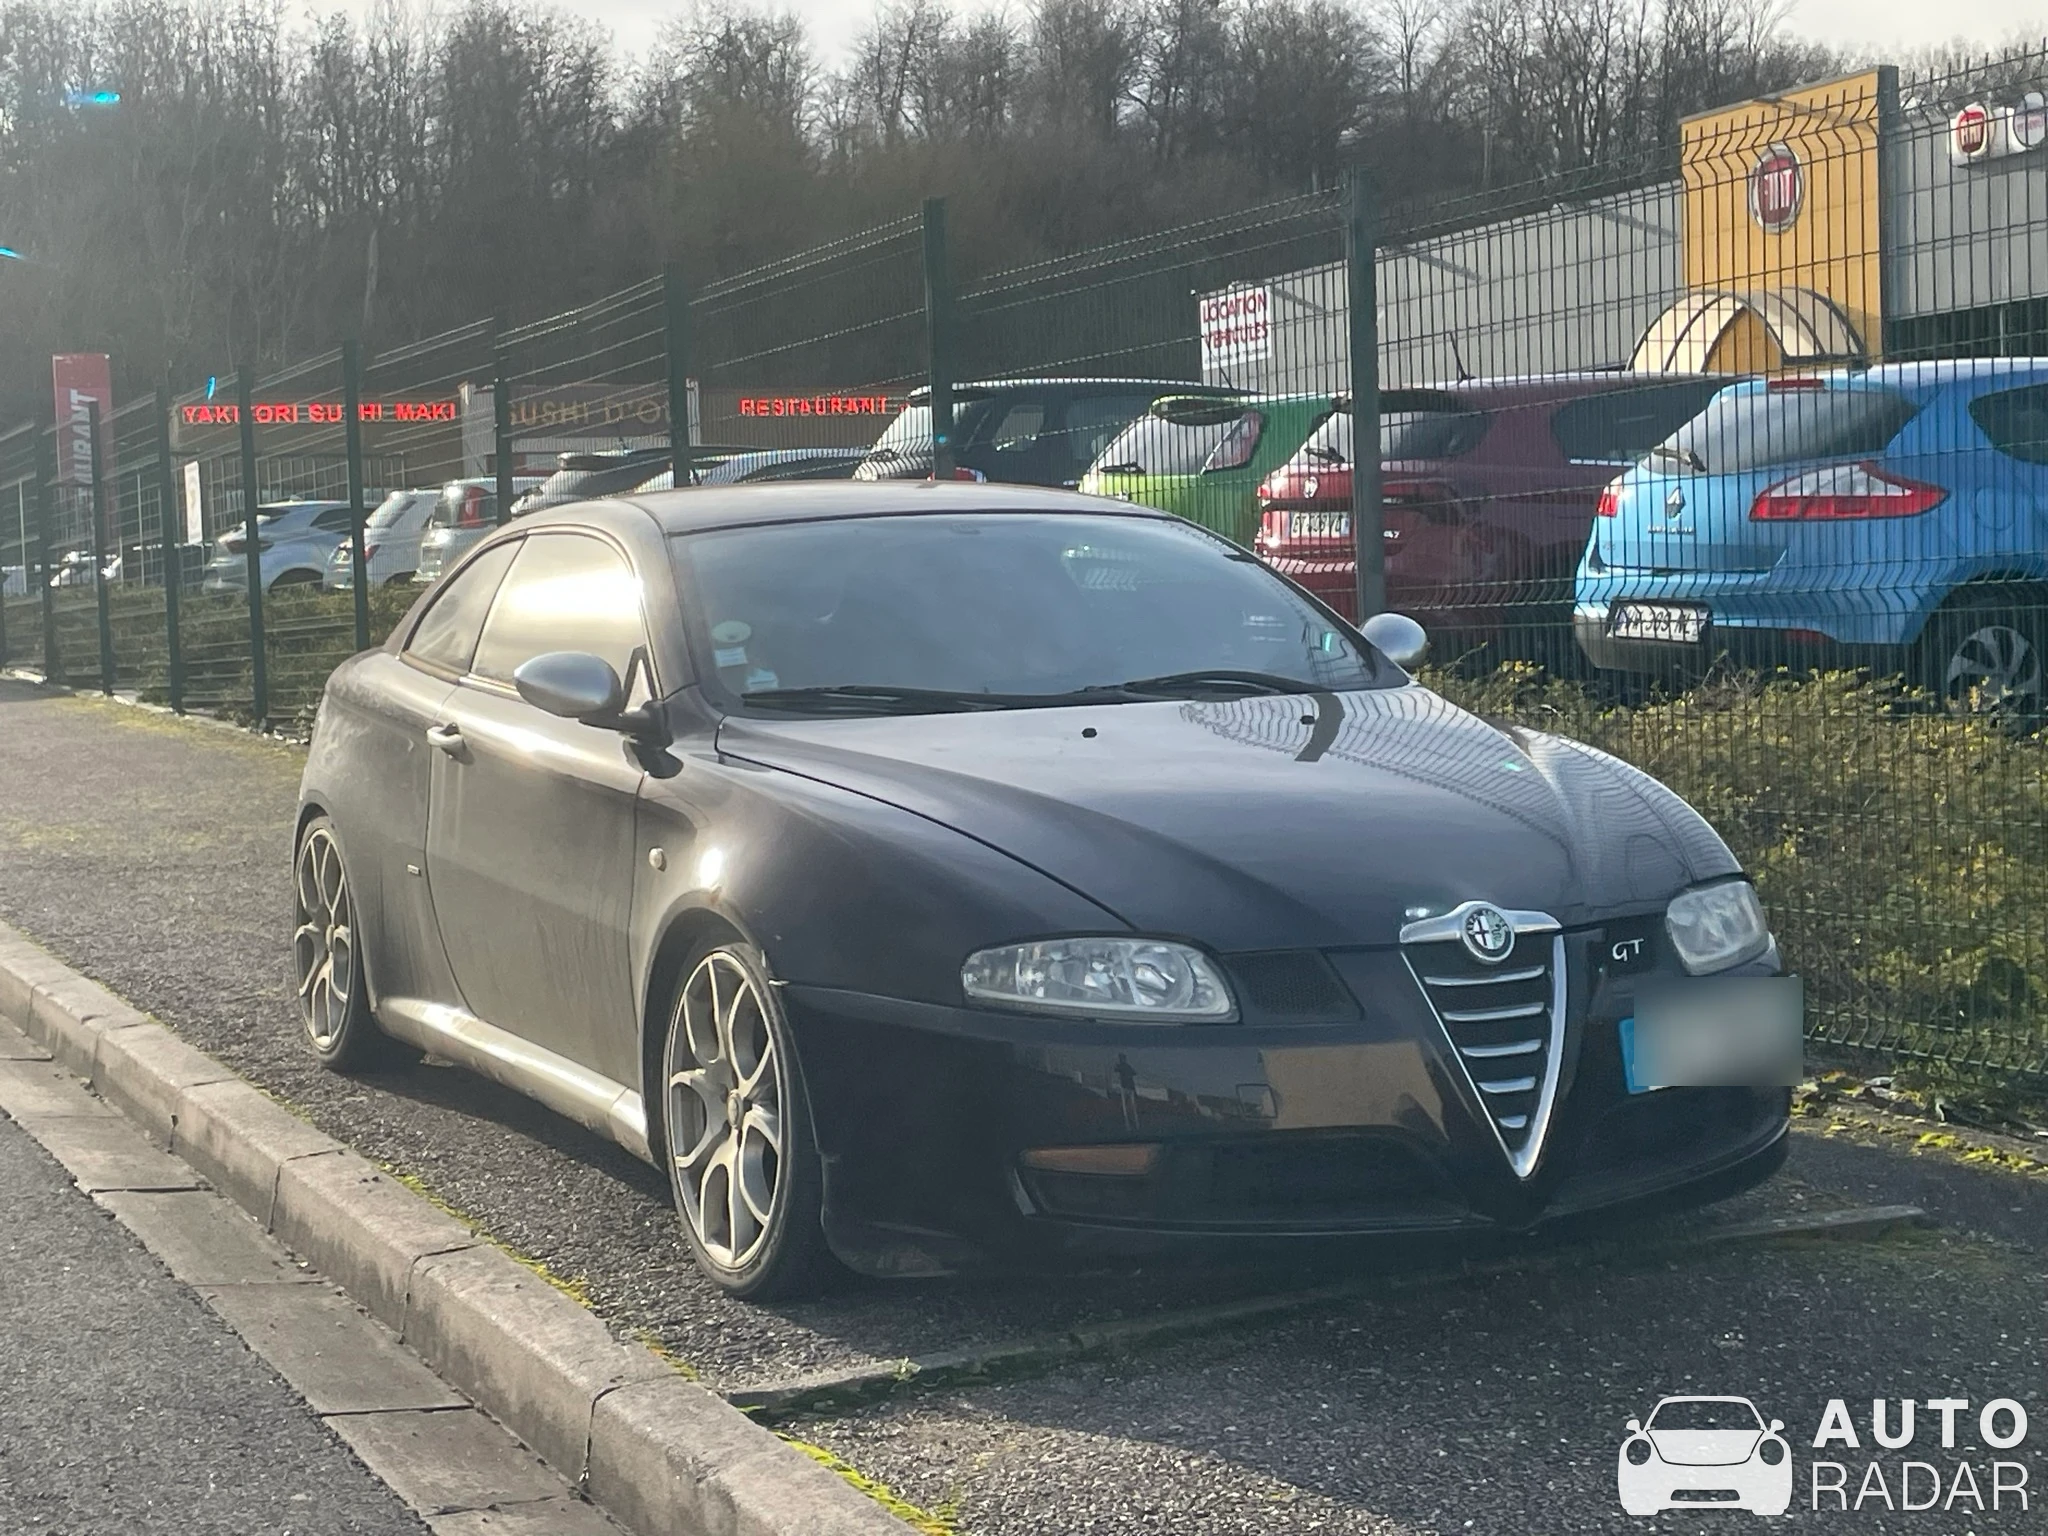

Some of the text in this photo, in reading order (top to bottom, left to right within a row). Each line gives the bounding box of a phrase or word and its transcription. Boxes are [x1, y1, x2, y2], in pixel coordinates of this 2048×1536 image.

[1202, 292, 1267, 323] LOCATION
[182, 402, 457, 424] YAKIORI SUHI MAKI
[739, 395, 888, 417] RESTAURANT
[1612, 938, 1645, 962] GT
